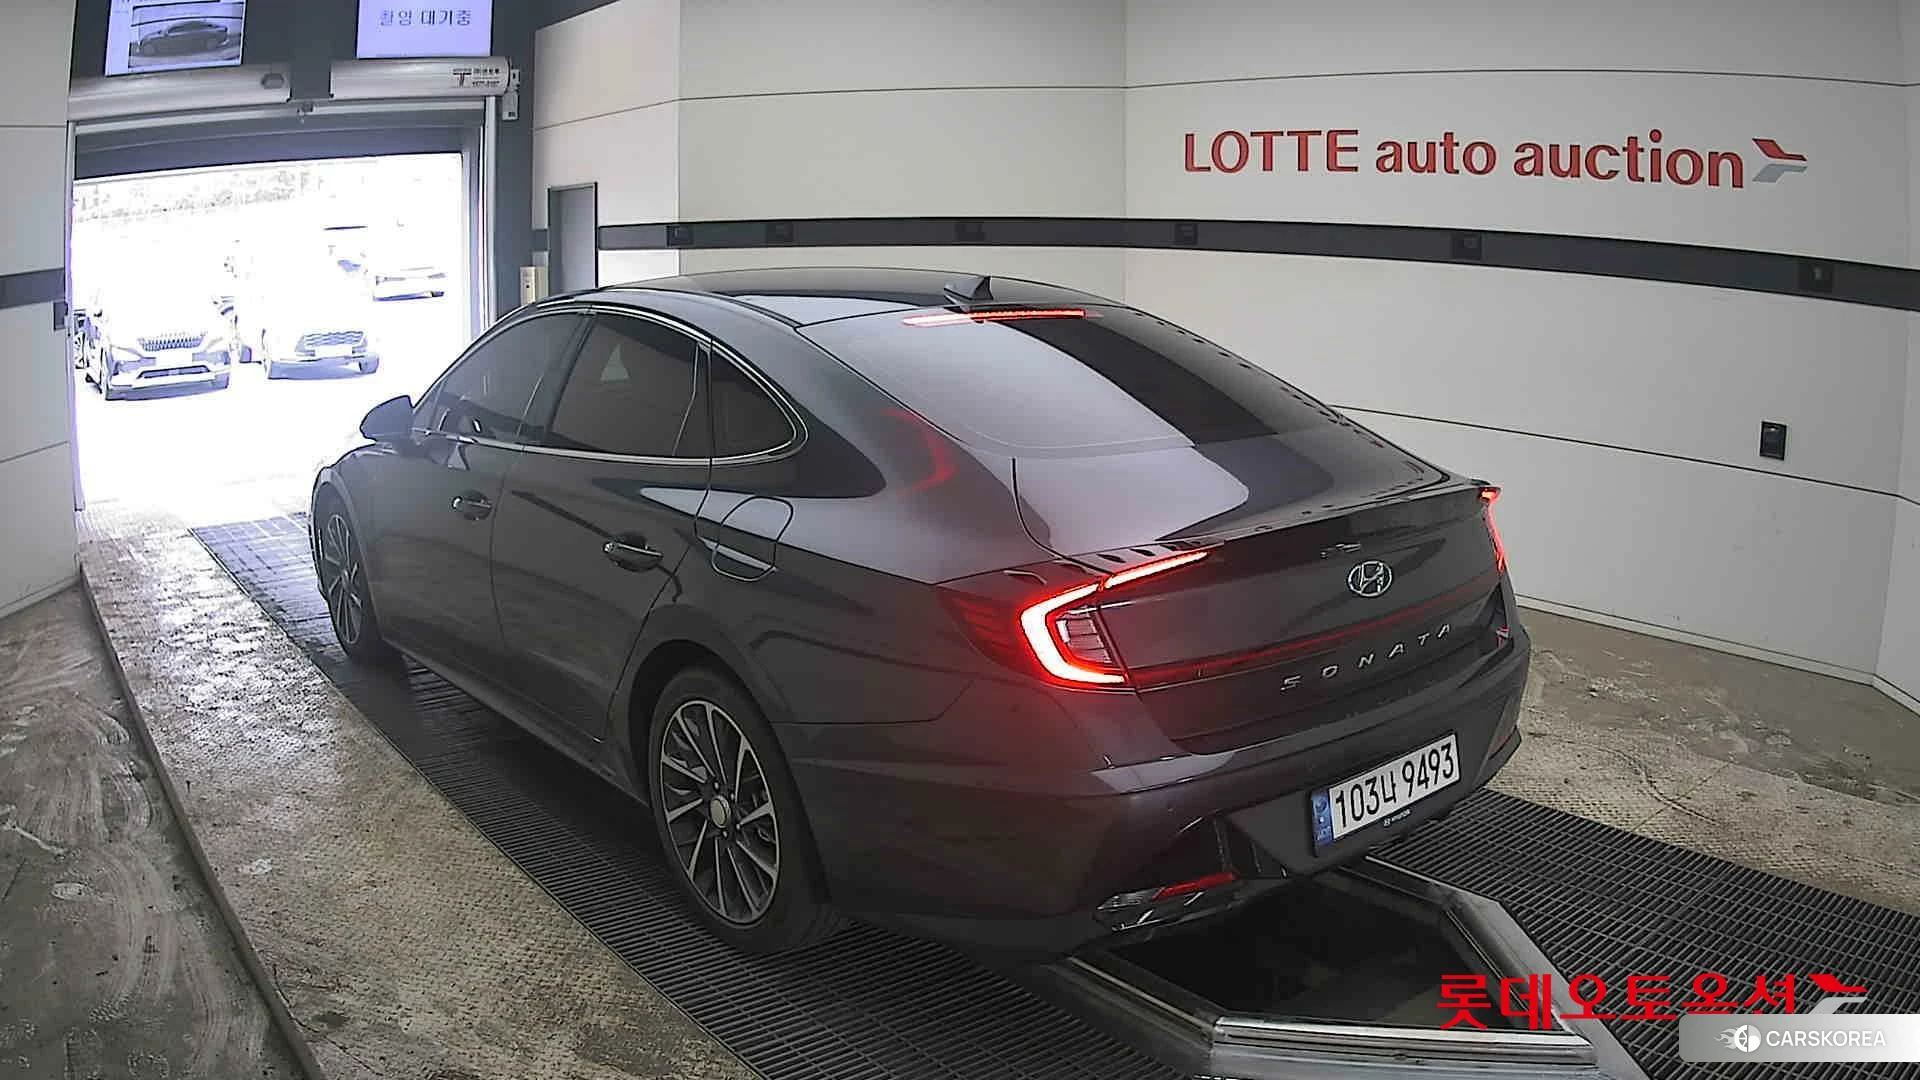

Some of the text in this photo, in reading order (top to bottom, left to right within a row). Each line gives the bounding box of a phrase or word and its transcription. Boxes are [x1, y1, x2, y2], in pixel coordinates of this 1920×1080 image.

[420, 9, 472, 26] 대기중
[1185, 129, 1744, 188] LOTTE auto auction
[1279, 623, 1452, 692] SONATA
[1335, 742, 1454, 828] 103나 9493
